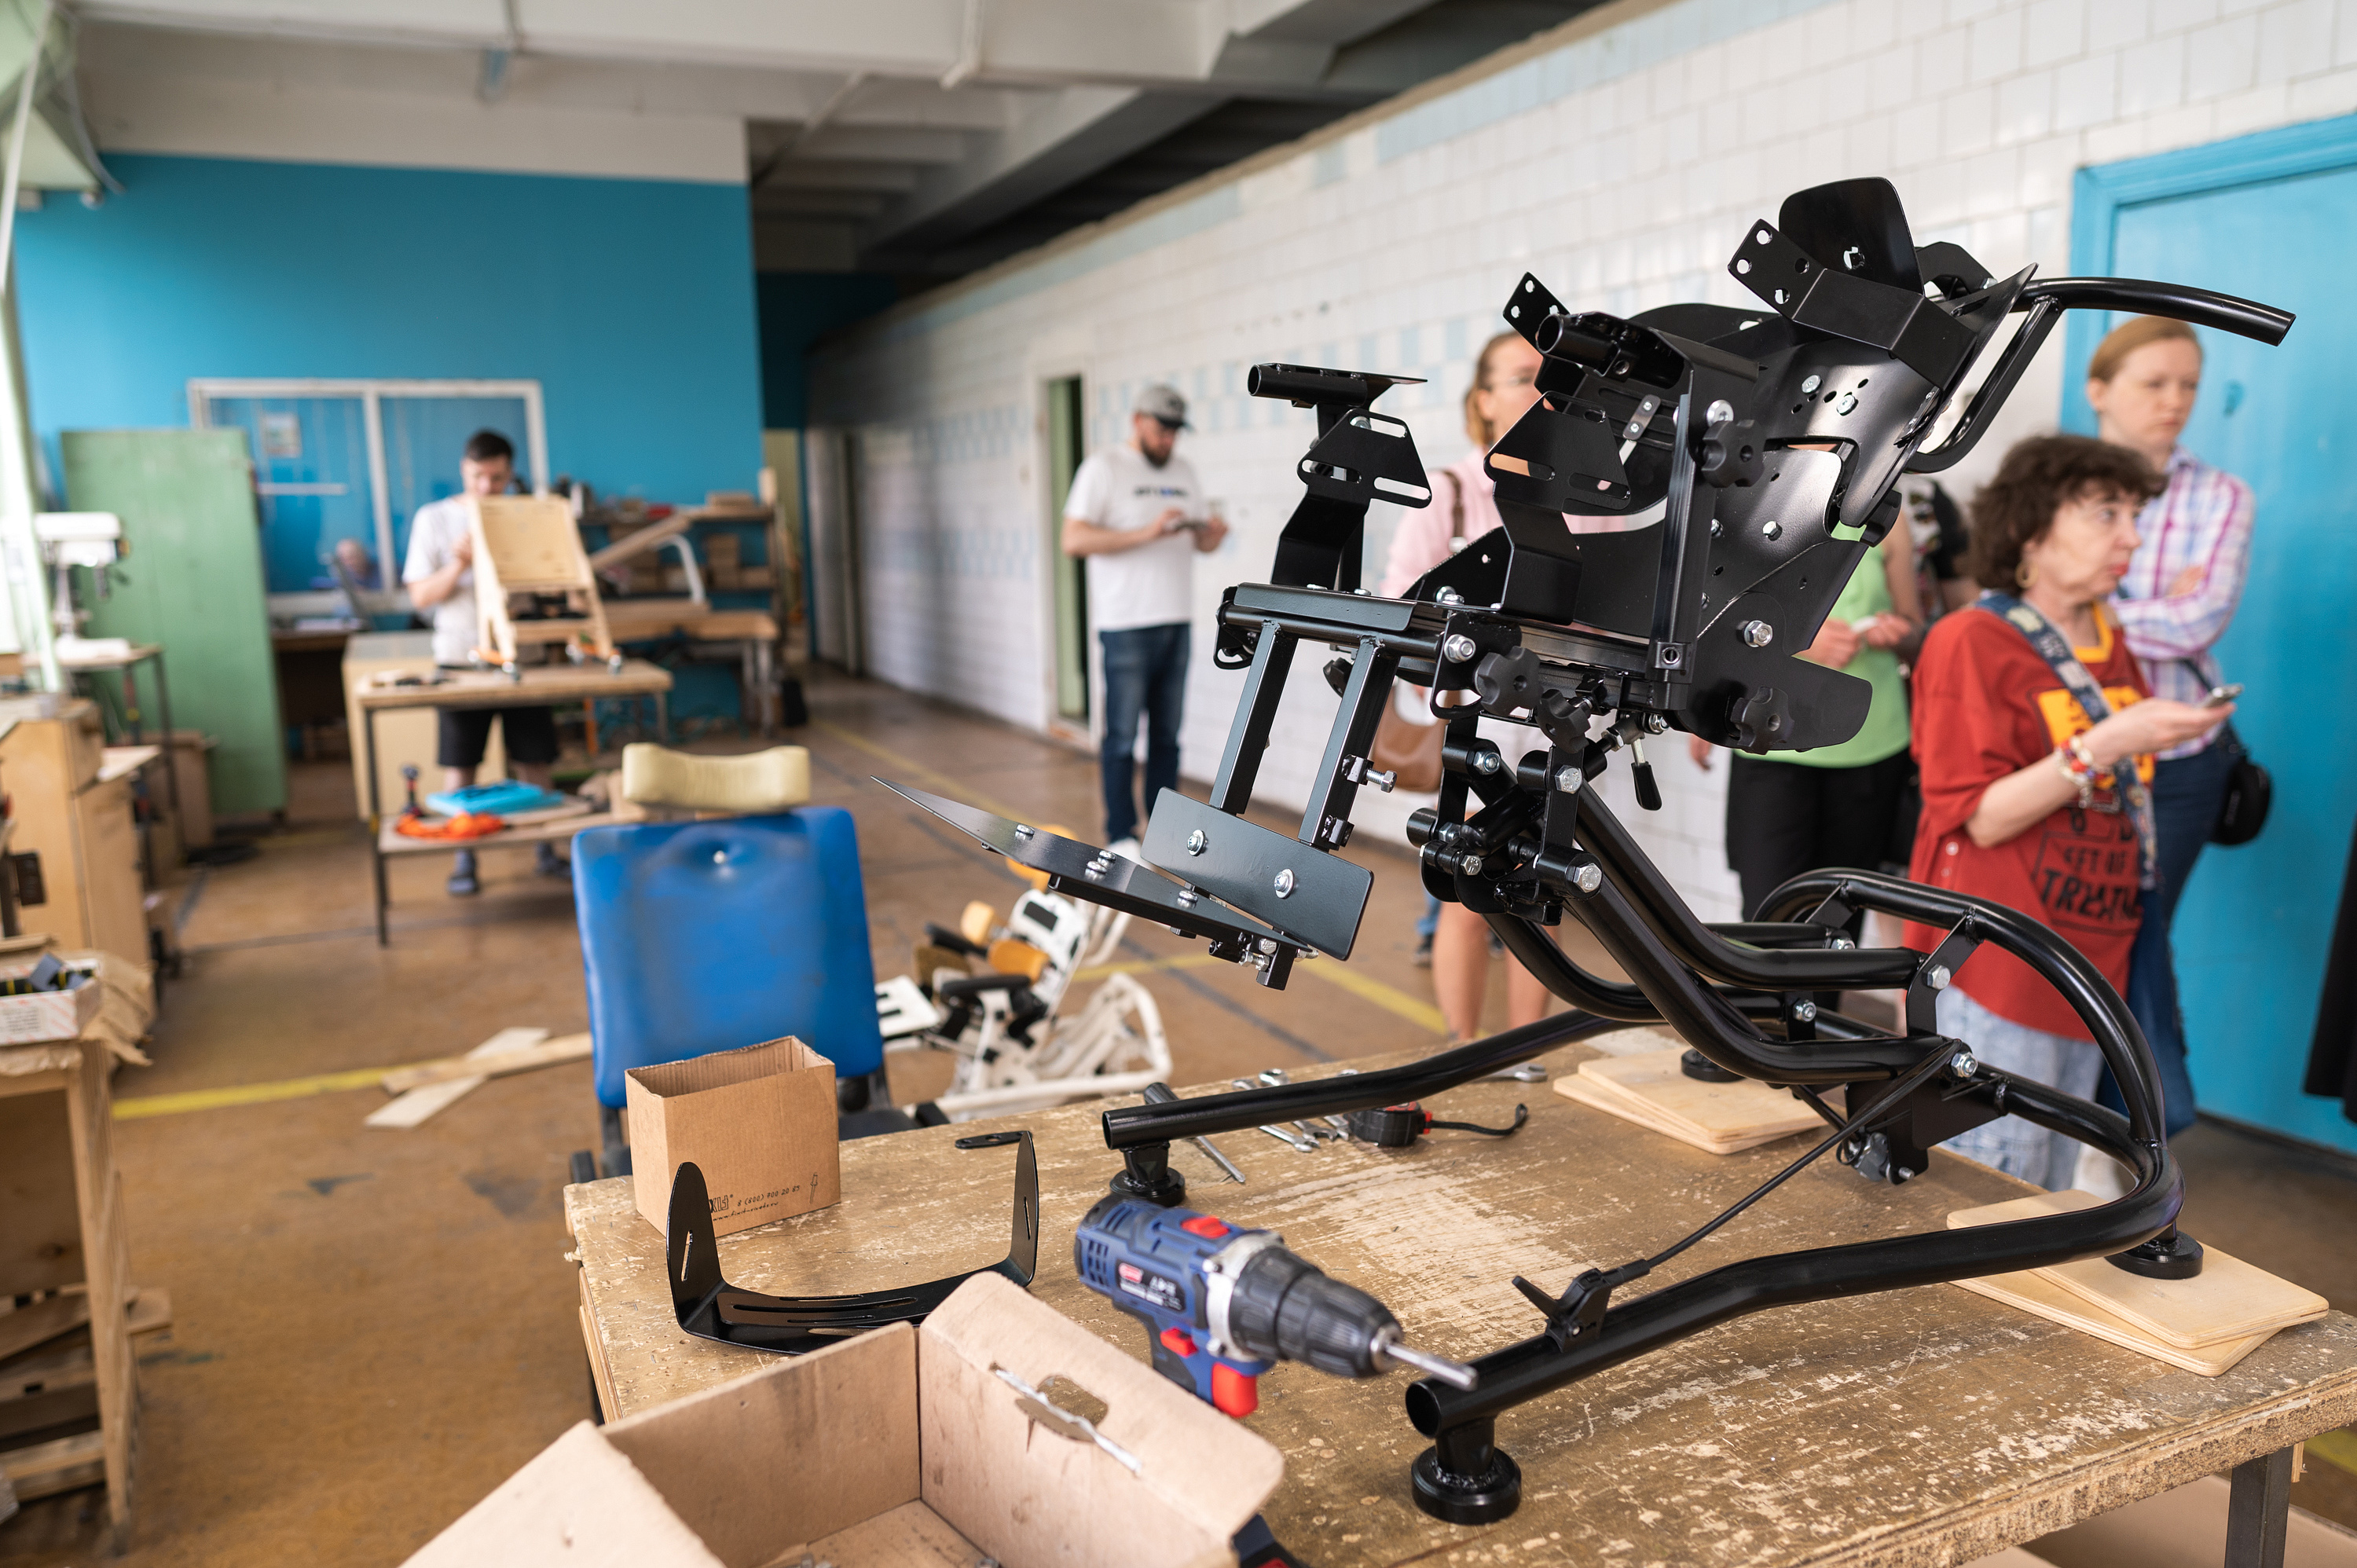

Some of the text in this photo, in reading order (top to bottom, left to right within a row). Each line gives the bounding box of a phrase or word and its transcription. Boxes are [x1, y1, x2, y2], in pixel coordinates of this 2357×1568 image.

[744, 1193, 764, 1205] (800)
[767, 1190, 779, 1199] 700
[781, 1187, 790, 1196] 20
